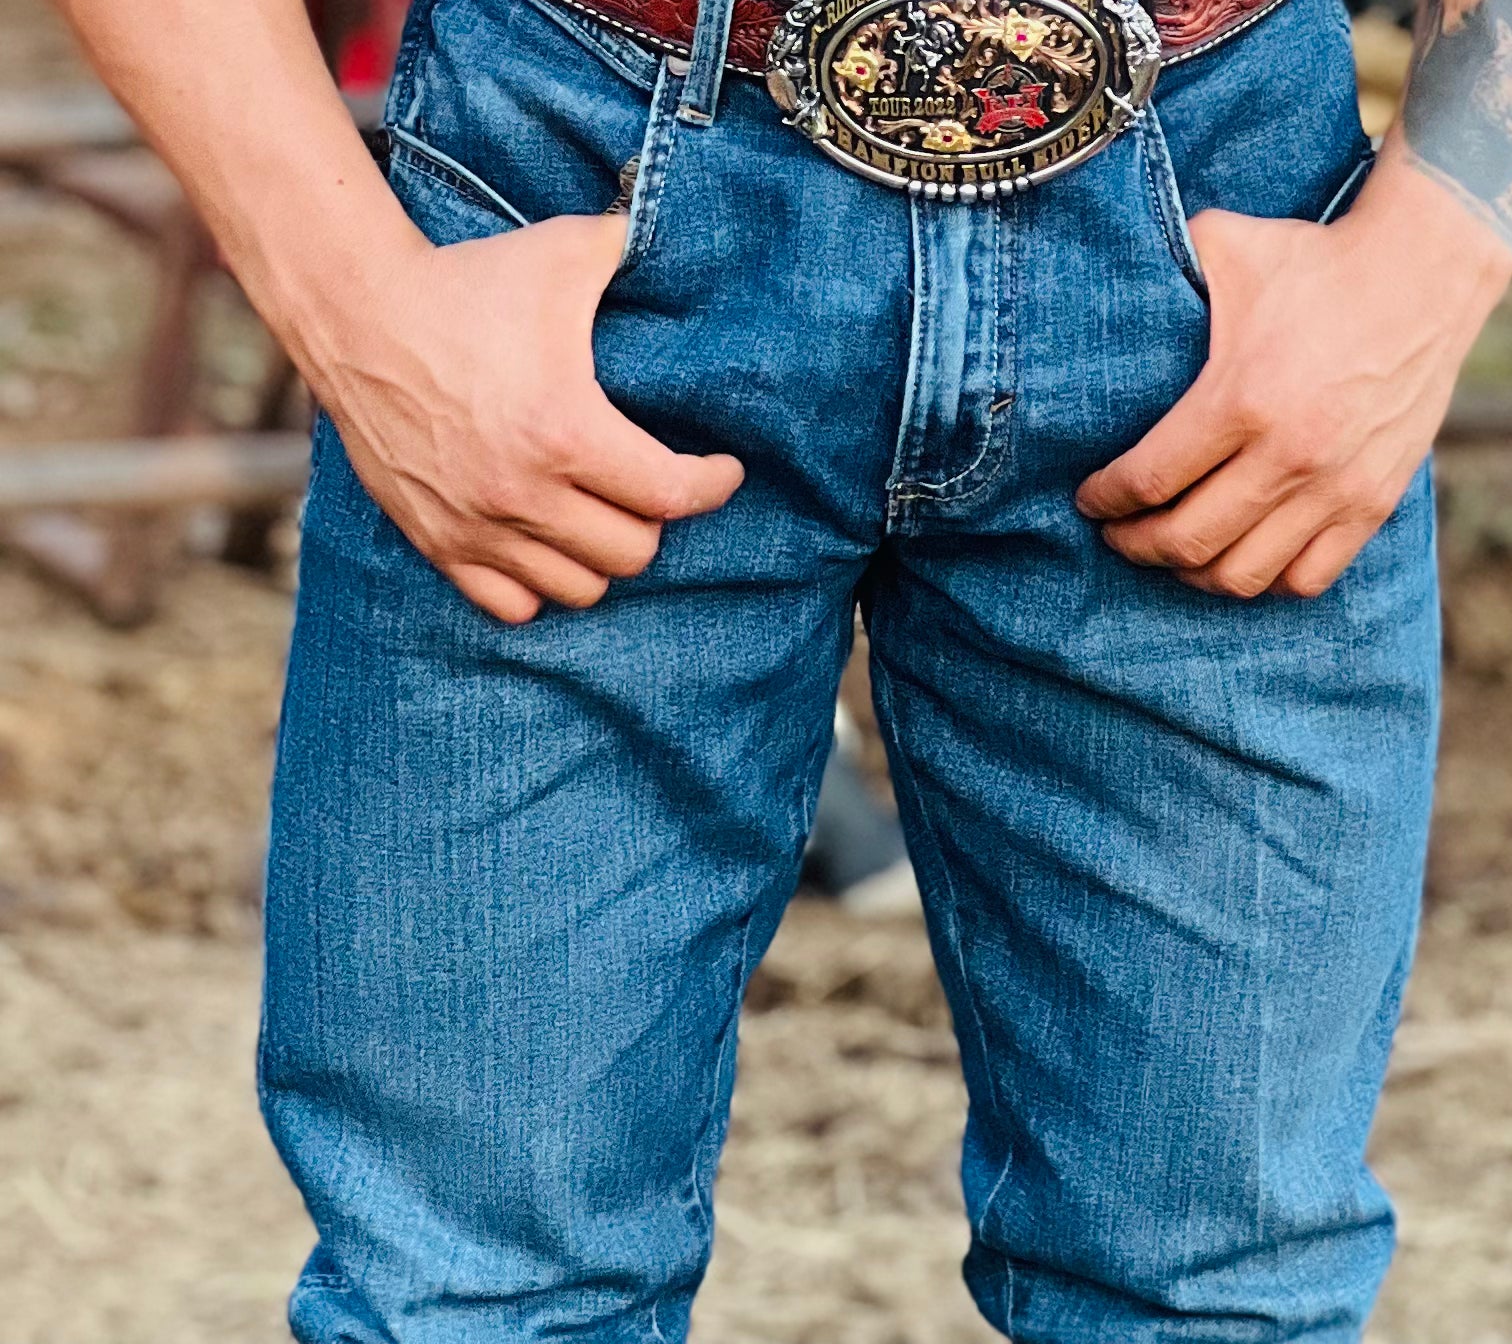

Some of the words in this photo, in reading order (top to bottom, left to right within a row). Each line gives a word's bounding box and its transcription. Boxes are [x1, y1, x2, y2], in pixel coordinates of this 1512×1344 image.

[868, 97, 911, 116] TOUR
[914, 96, 957, 116] 2022
[961, 158, 1026, 183] BULL
[1033, 93, 1107, 170] RIDER
